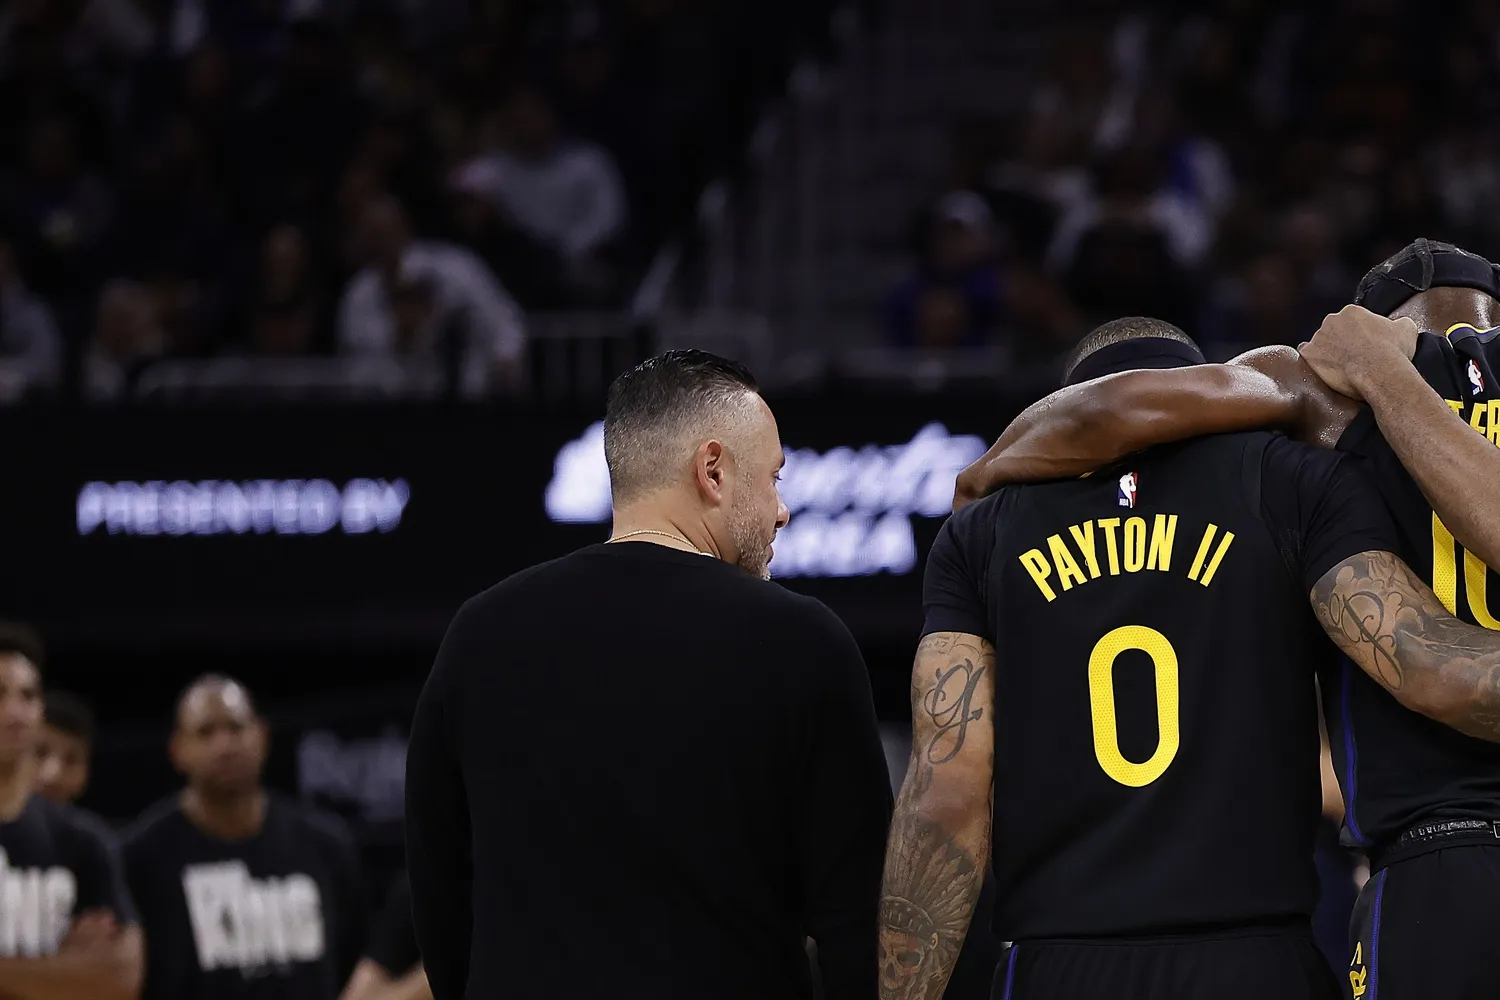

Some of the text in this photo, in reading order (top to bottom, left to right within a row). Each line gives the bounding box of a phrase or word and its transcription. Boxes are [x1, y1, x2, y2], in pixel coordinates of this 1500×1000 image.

[77, 477, 410, 535] PRESENTED BY
[1018, 514, 1236, 602] PAYTON II
[1088, 625, 1180, 788] 0
